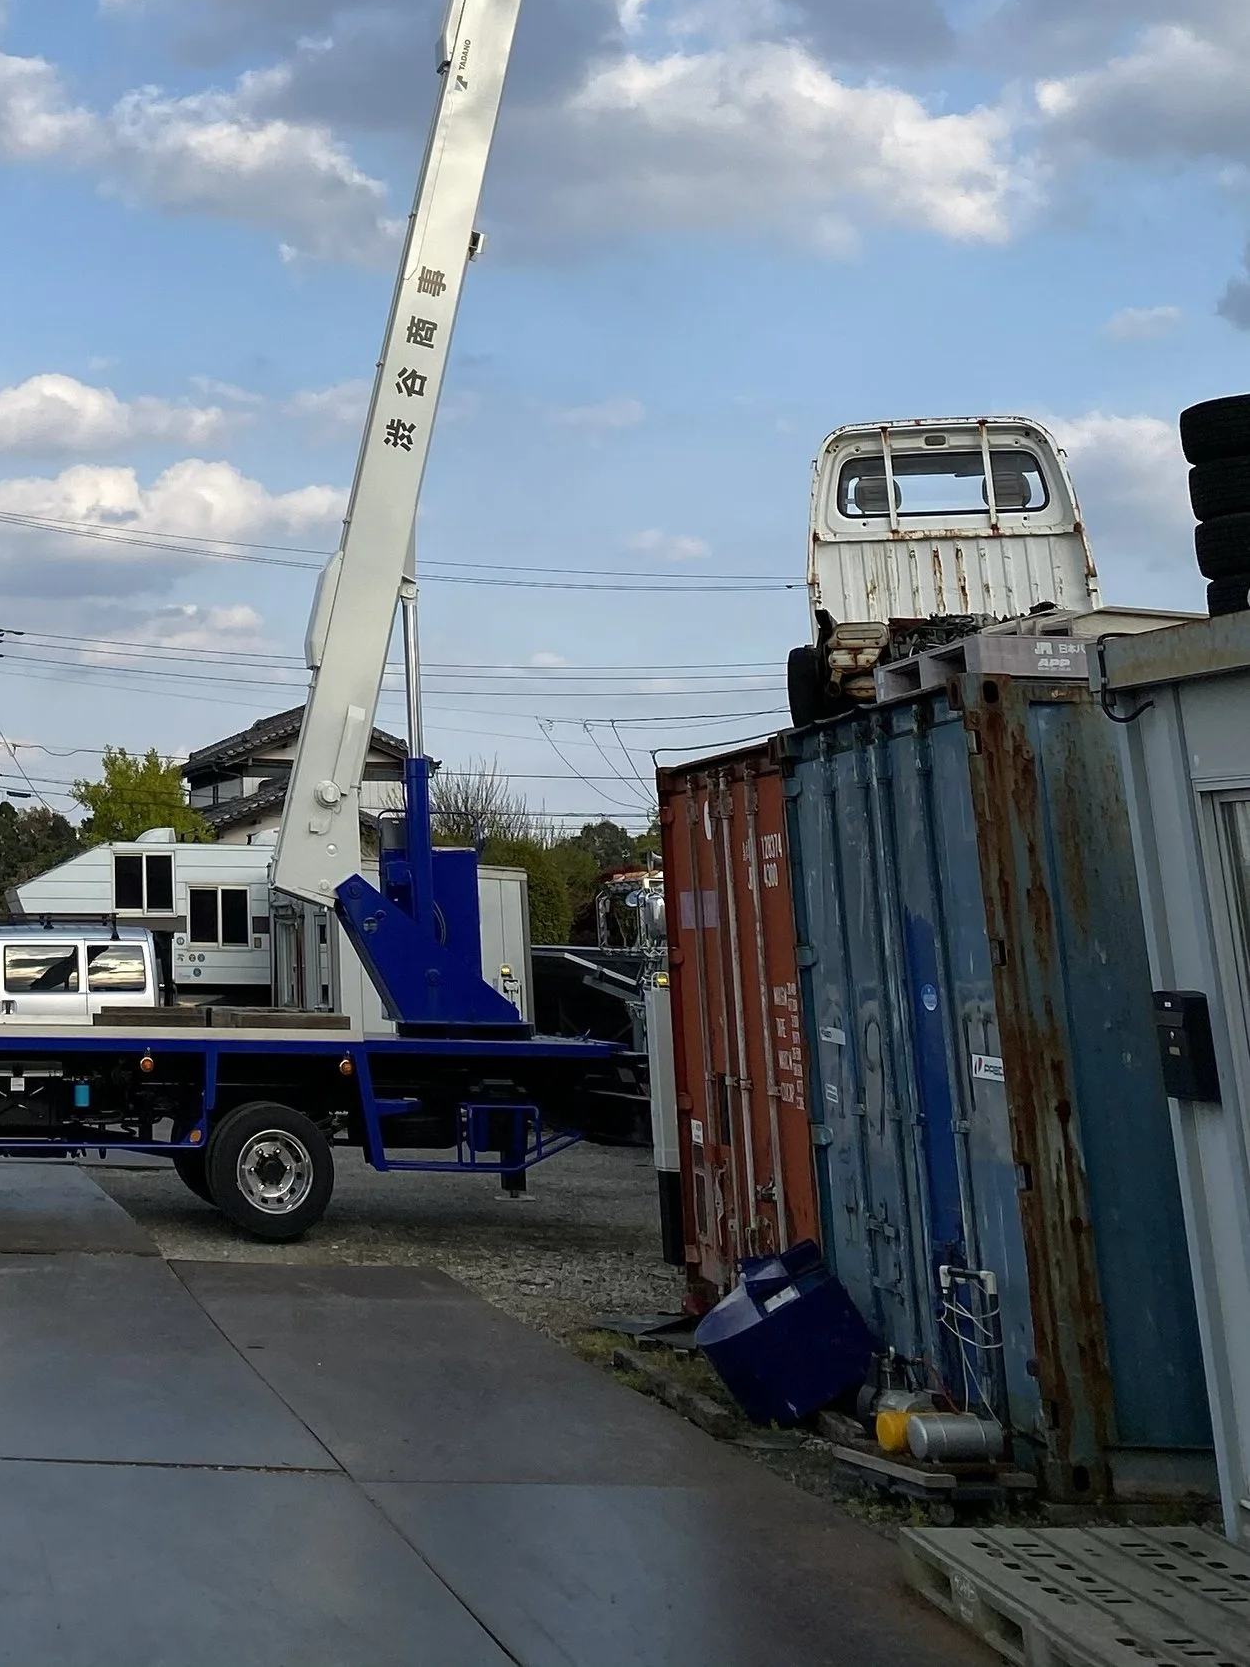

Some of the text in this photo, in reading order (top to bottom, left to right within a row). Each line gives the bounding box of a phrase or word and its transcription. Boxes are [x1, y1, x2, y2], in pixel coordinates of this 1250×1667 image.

[457, 38, 473, 71] TADANO
[382, 265, 448, 453] 渋谷商事
